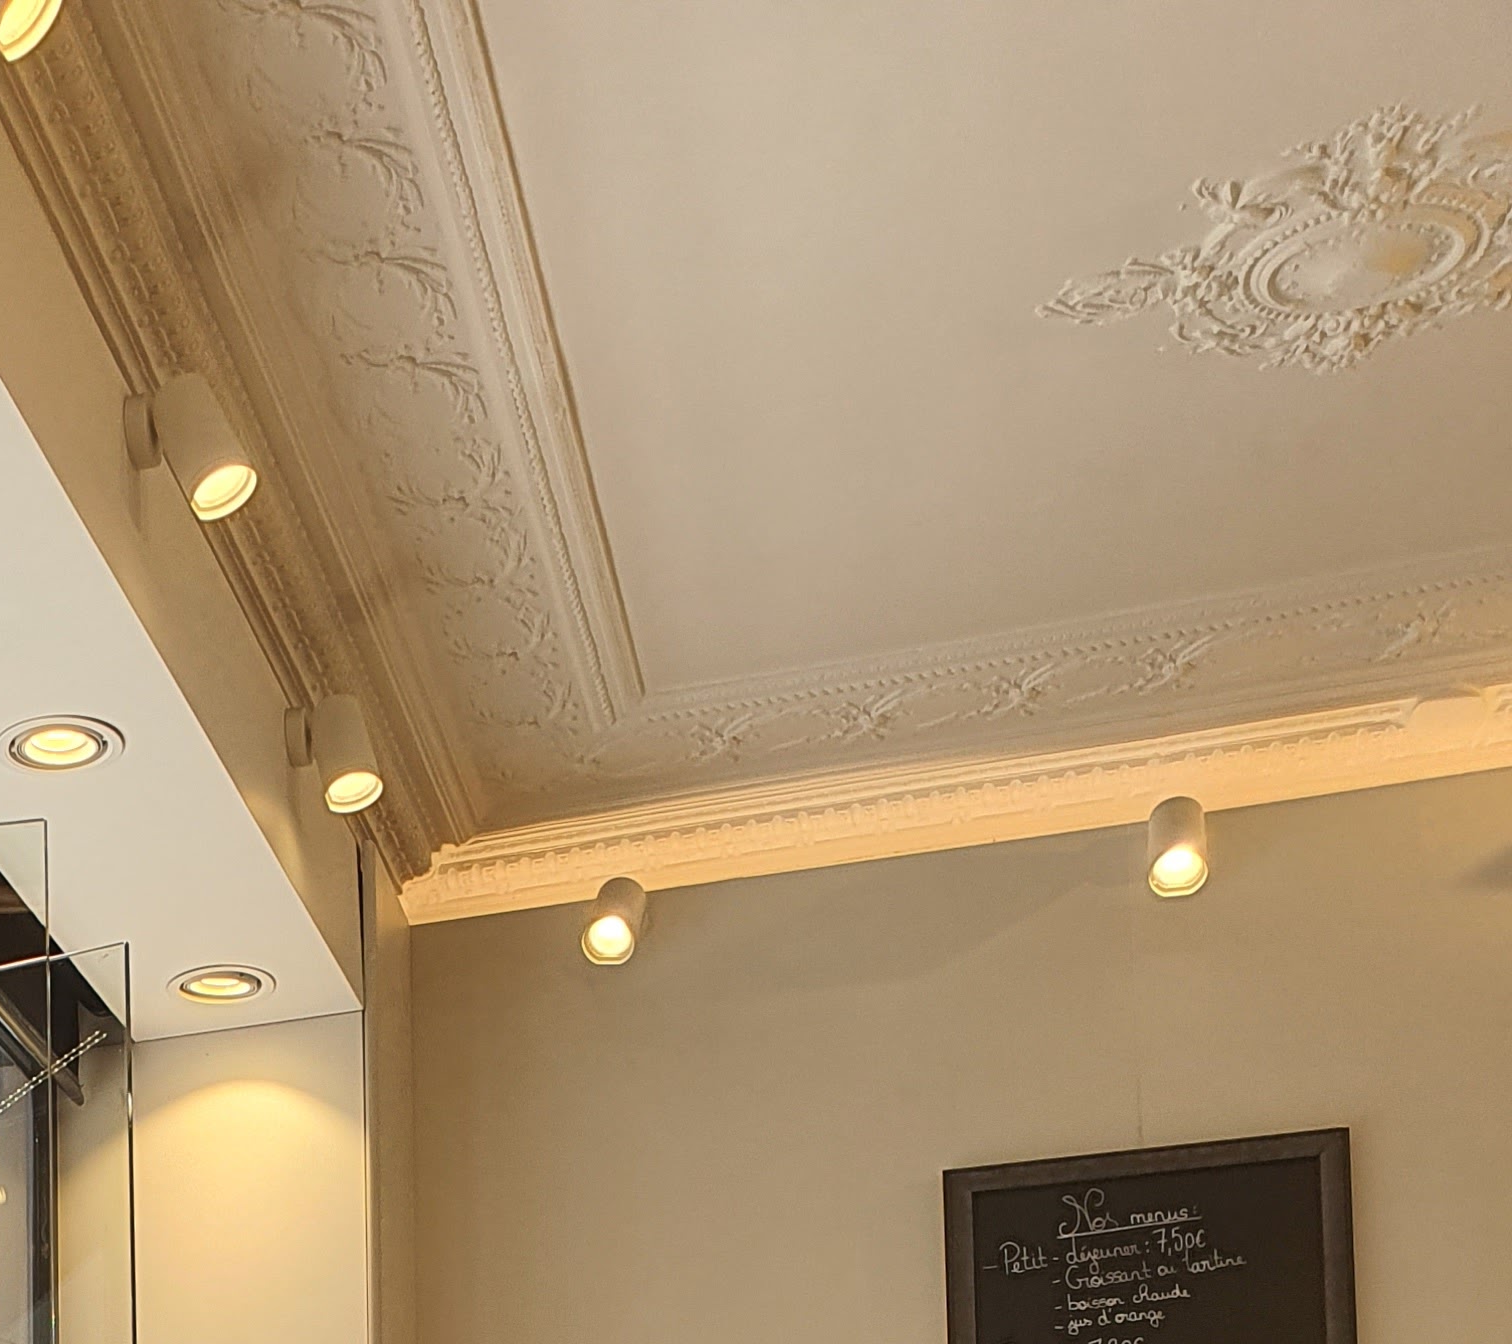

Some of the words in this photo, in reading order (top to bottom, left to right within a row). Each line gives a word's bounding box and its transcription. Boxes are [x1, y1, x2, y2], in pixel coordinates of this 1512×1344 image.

[1058, 1188, 1118, 1236] Nos
[1152, 1229, 1206, 1256] 7,50€
[1065, 1262, 1151, 1289] Croissant
[1158, 1265, 1177, 1277] ou
[1182, 1249, 1246, 1274] tartine
[1068, 1294, 1123, 1311] boisson
[1133, 1283, 1190, 1303] chaude
[1068, 1315, 1092, 1335] jus
